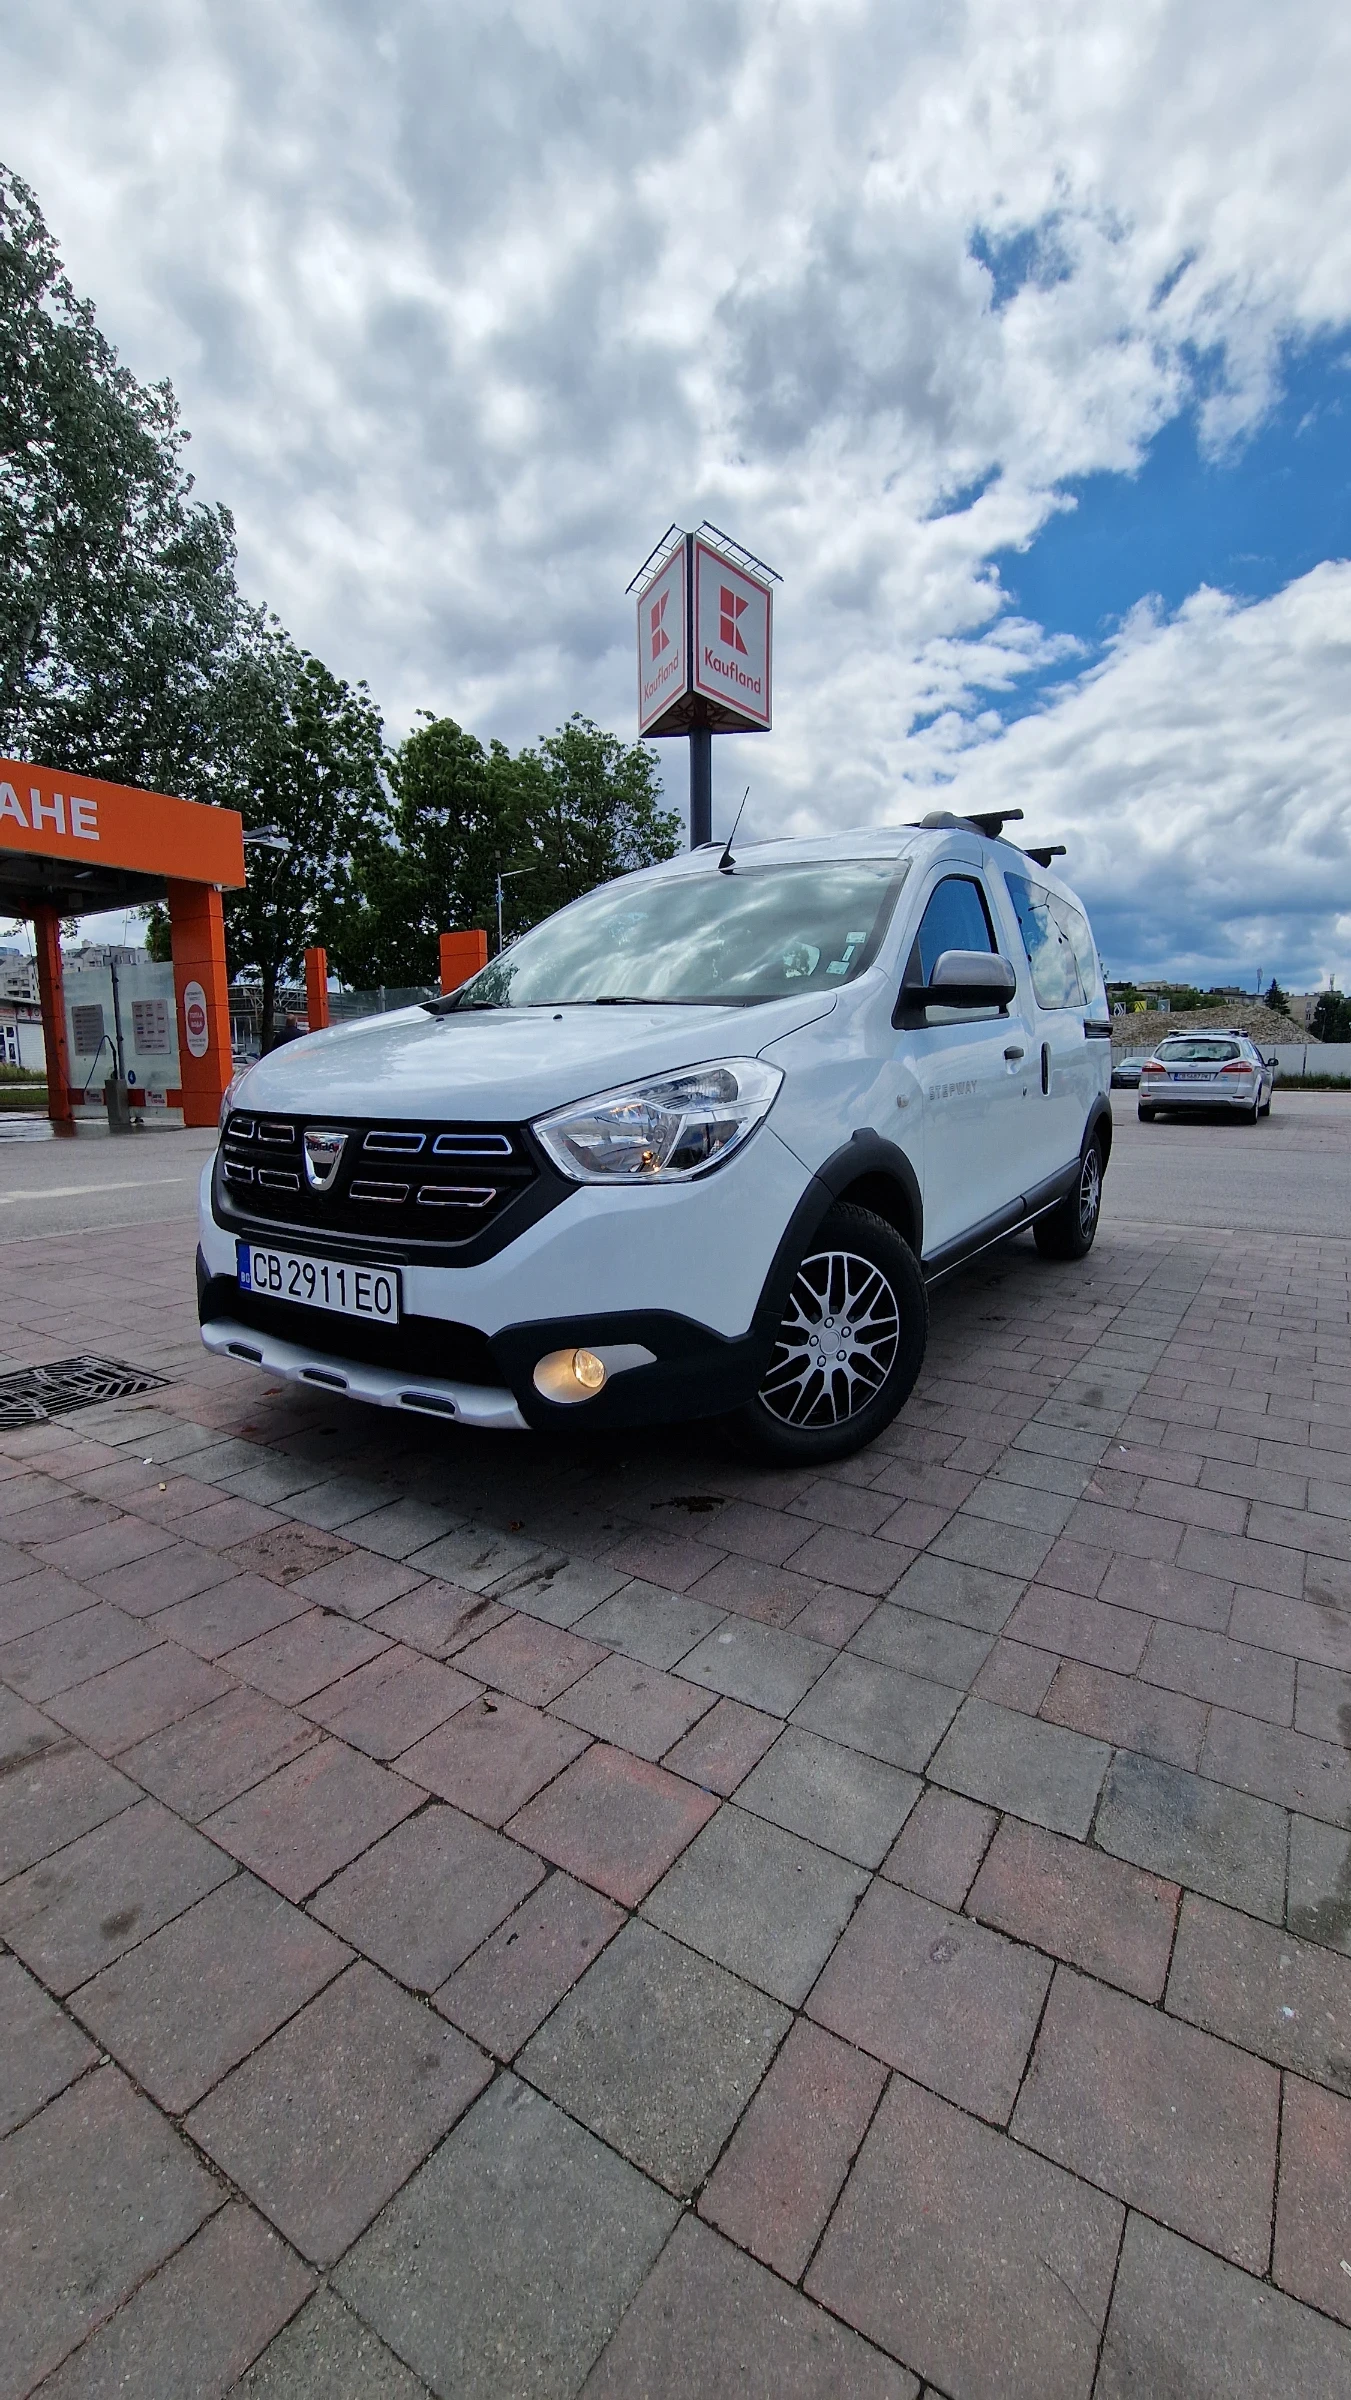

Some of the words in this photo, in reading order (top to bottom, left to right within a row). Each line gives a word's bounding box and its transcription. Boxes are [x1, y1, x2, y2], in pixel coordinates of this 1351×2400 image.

[643, 649, 679, 702] Kaufland
[704, 646, 761, 695] Kaufland
[929, 1080, 977, 1101] STEPWAY
[240, 1271, 251, 1284] BG
[253, 1252, 283, 1291] CB
[287, 1259, 347, 1306] 2911
